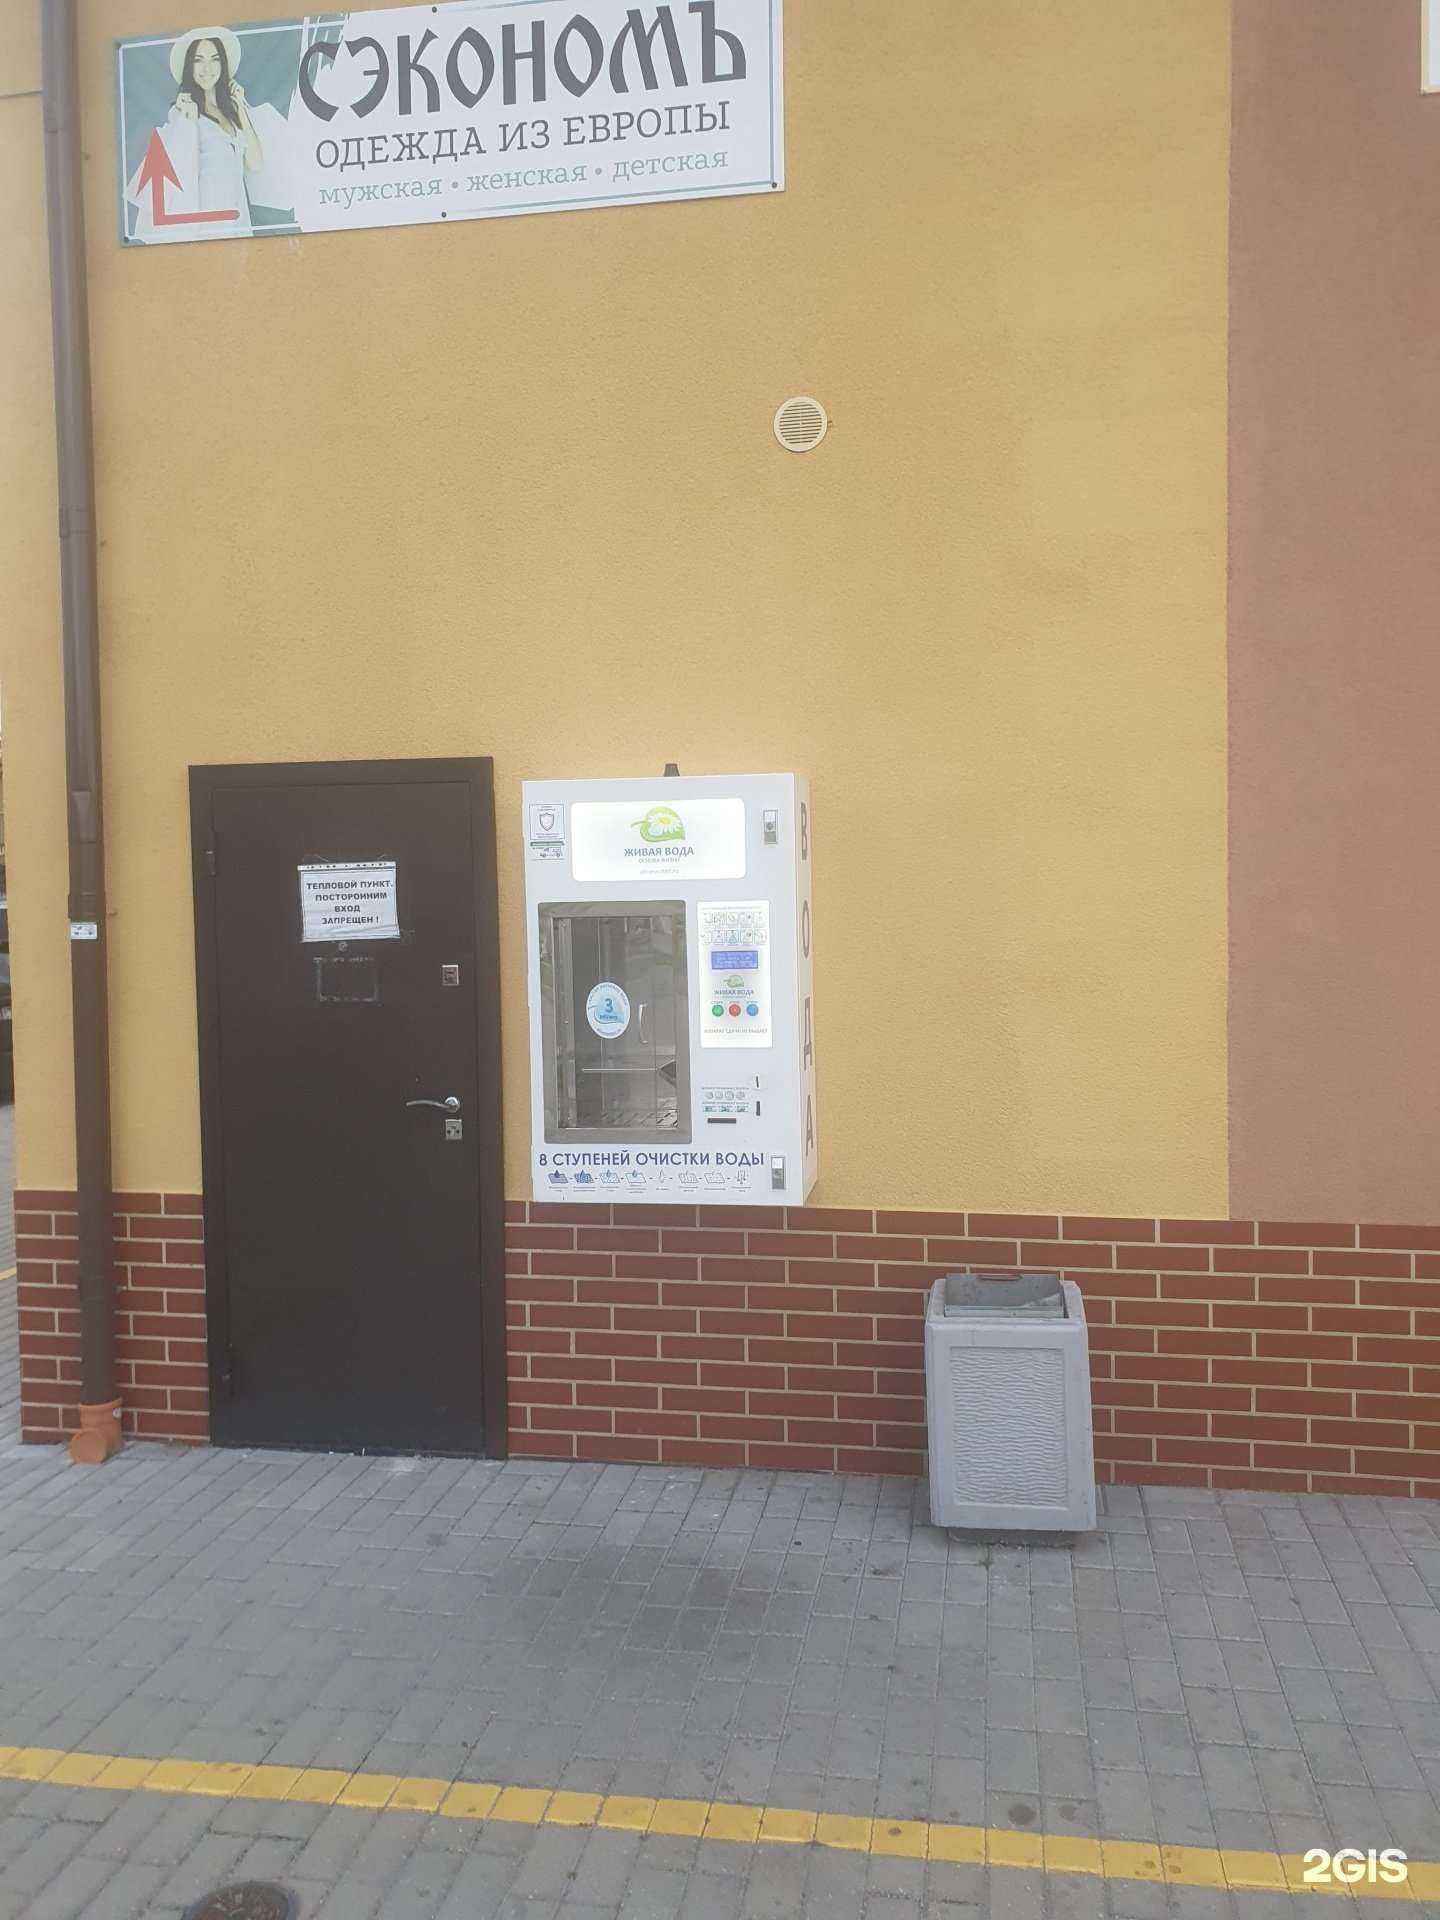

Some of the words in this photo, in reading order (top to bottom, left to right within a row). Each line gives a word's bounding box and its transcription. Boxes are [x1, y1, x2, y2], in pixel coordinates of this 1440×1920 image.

[299, 0, 746, 122] СЭКОНОМЪ
[316, 126, 487, 172] ОДЕЖДА
[498, 119, 551, 152] ИЗ
[563, 101, 730, 146] ЕВРОПЫ
[319, 178, 443, 210] мужская
[466, 165, 588, 192] женская
[612, 151, 729, 183] детская
[624, 847, 662, 857] ЖИВАЯ
[664, 846, 695, 857] ВОДА
[306, 881, 358, 890] ТЕПЛОВОЙ
[360, 880, 393, 888] ПУНКТ.
[315, 892, 388, 901] ПОСТОРОННИМ
[321, 917, 373, 925] ЗАПРЕЩЕН
[604, 998, 613, 1013] 3
[539, 1154, 548, 1166] 8
[552, 1150, 630, 1166] СТУПЕНЕЙ
[635, 1152, 709, 1166] ОЧИСТКИ
[715, 1152, 764, 1167] ВОДЫ
